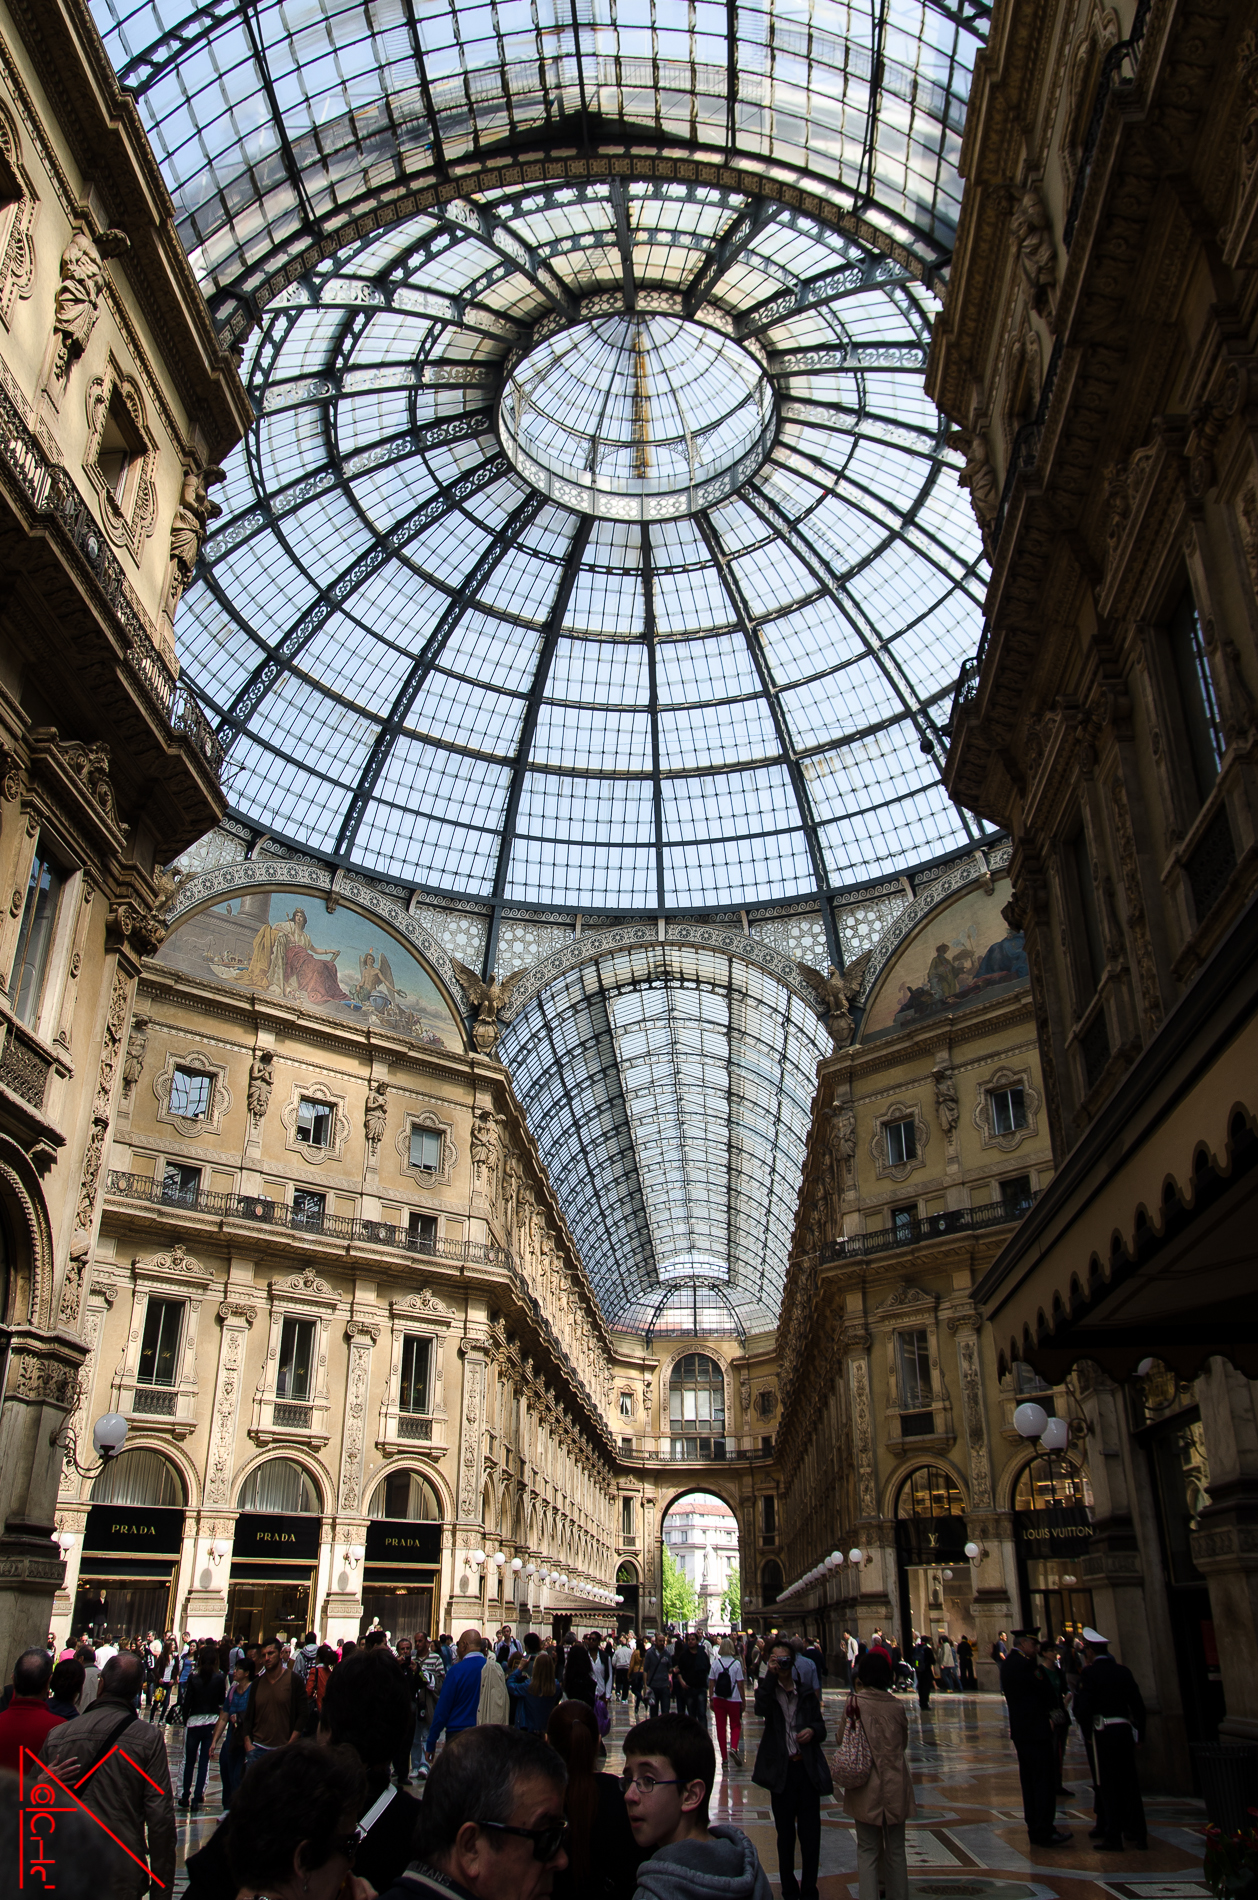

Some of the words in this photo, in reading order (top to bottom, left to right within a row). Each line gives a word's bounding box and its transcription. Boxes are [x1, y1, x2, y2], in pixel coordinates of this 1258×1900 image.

[111, 1524, 156, 1535] PRADA
[1023, 1529, 1050, 1540] LOUIS
[1051, 1527, 1094, 1538] VUITTON
[256, 1532, 296, 1542] PRADA
[385, 1538, 420, 1547] PRADA
